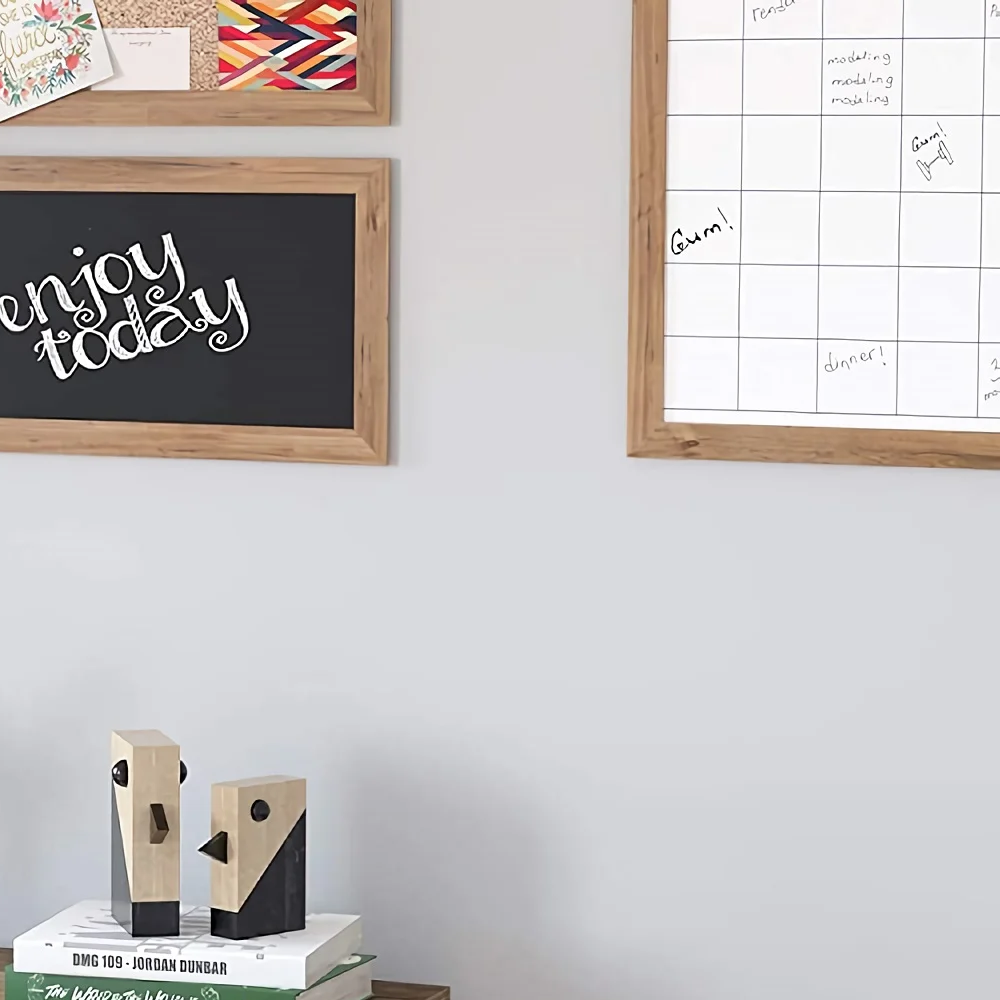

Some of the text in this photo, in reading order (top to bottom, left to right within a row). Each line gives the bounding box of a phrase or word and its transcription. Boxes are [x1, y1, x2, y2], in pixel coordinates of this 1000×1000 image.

[33, 277, 249, 380] today
[824, 346, 887, 373] dinner!
[72, 953, 99, 967] DMG
[102, 955, 123, 969] 109
[132, 956, 177, 973] JORDAN
[180, 960, 227, 976] DUNBAR
